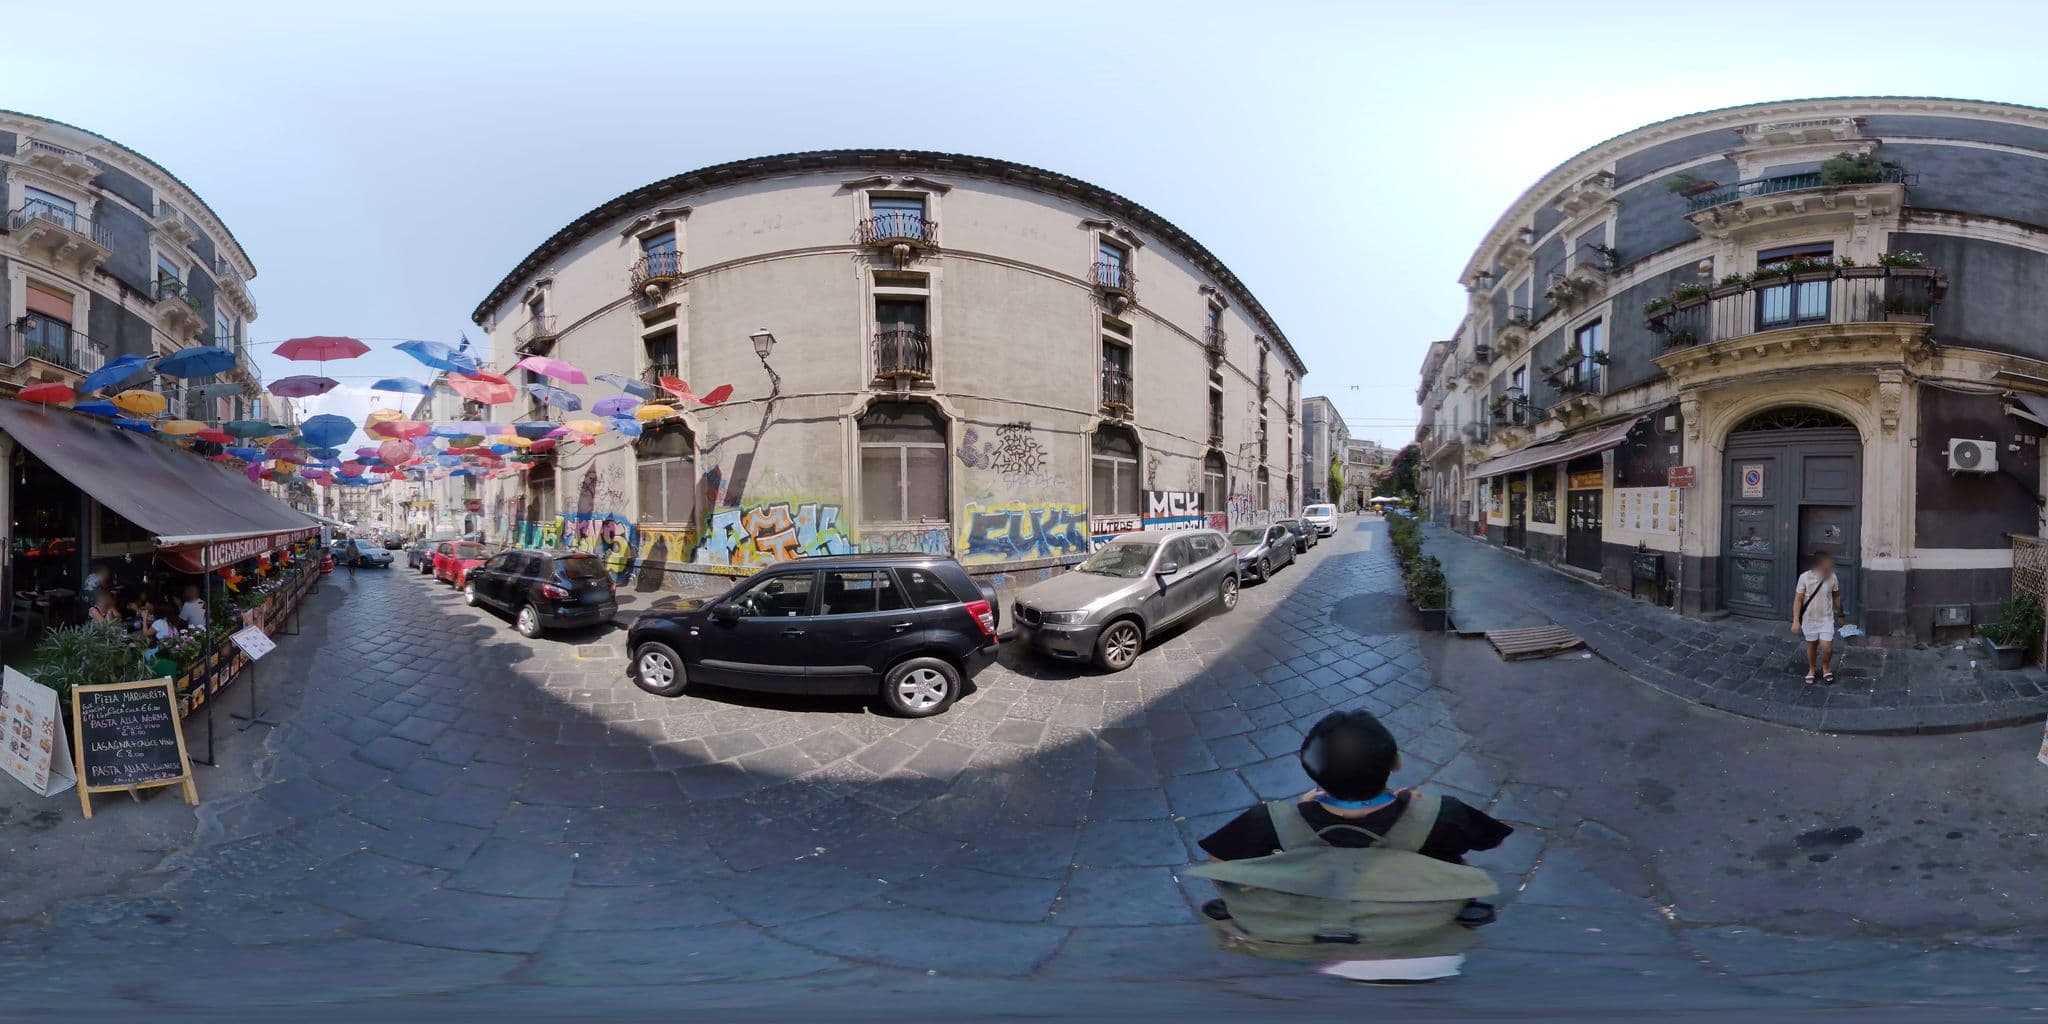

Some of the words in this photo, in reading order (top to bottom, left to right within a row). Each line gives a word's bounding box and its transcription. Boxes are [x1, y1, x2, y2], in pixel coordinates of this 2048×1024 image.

[91, 718, 118, 729] PASTA
[120, 716, 139, 725] ALLA
[141, 713, 169, 722] NORMA
[91, 765, 122, 777] PASTA
